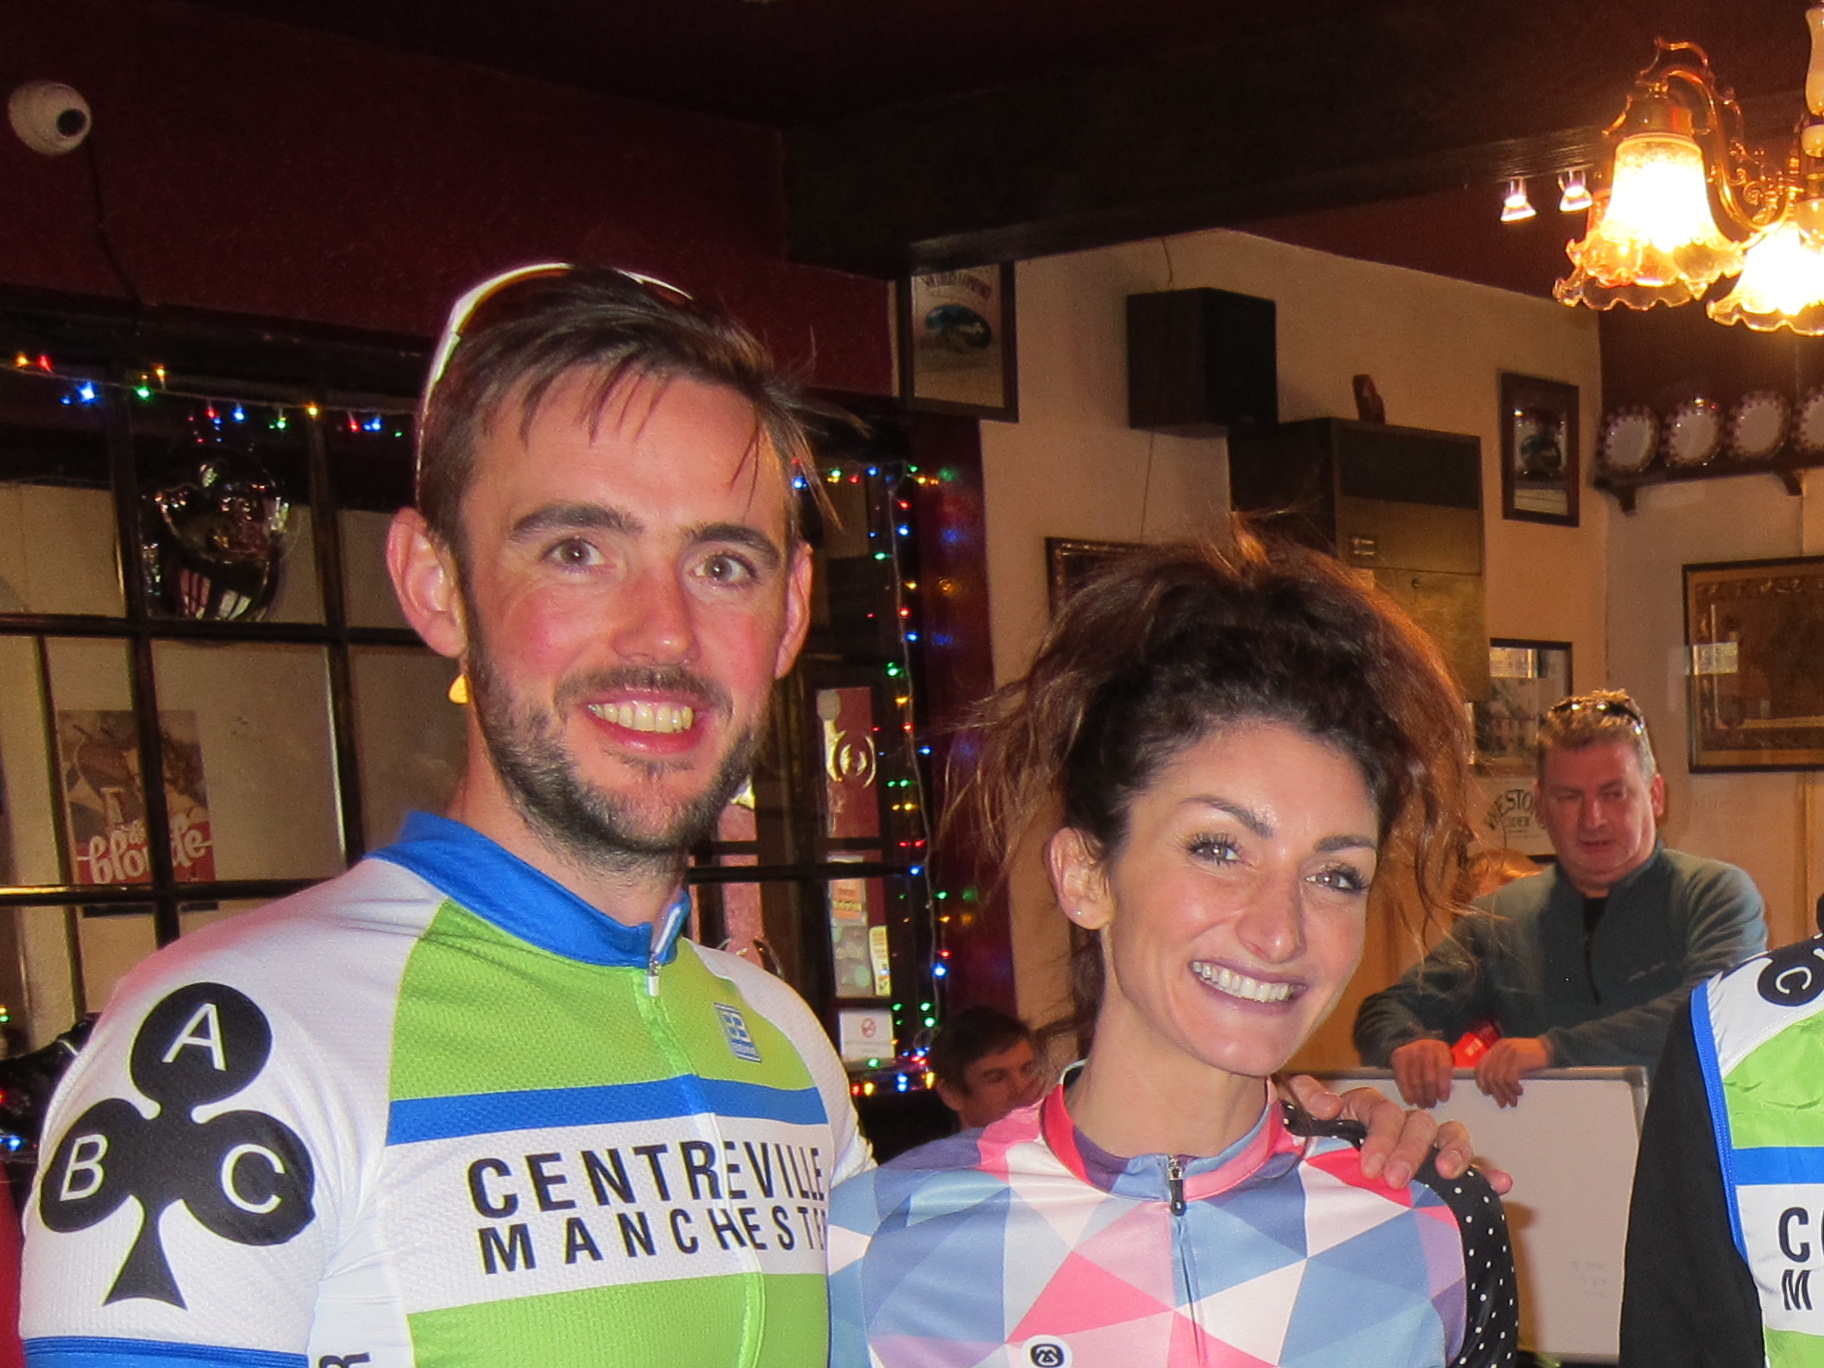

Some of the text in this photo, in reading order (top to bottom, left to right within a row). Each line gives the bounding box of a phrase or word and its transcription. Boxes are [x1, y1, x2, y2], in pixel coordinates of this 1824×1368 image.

[1775, 966, 1813, 994] C
[162, 1003, 226, 1071] A
[60, 1134, 109, 1202] B
[221, 1143, 287, 1214] C
[466, 1140, 825, 1219] CENTREVILLE
